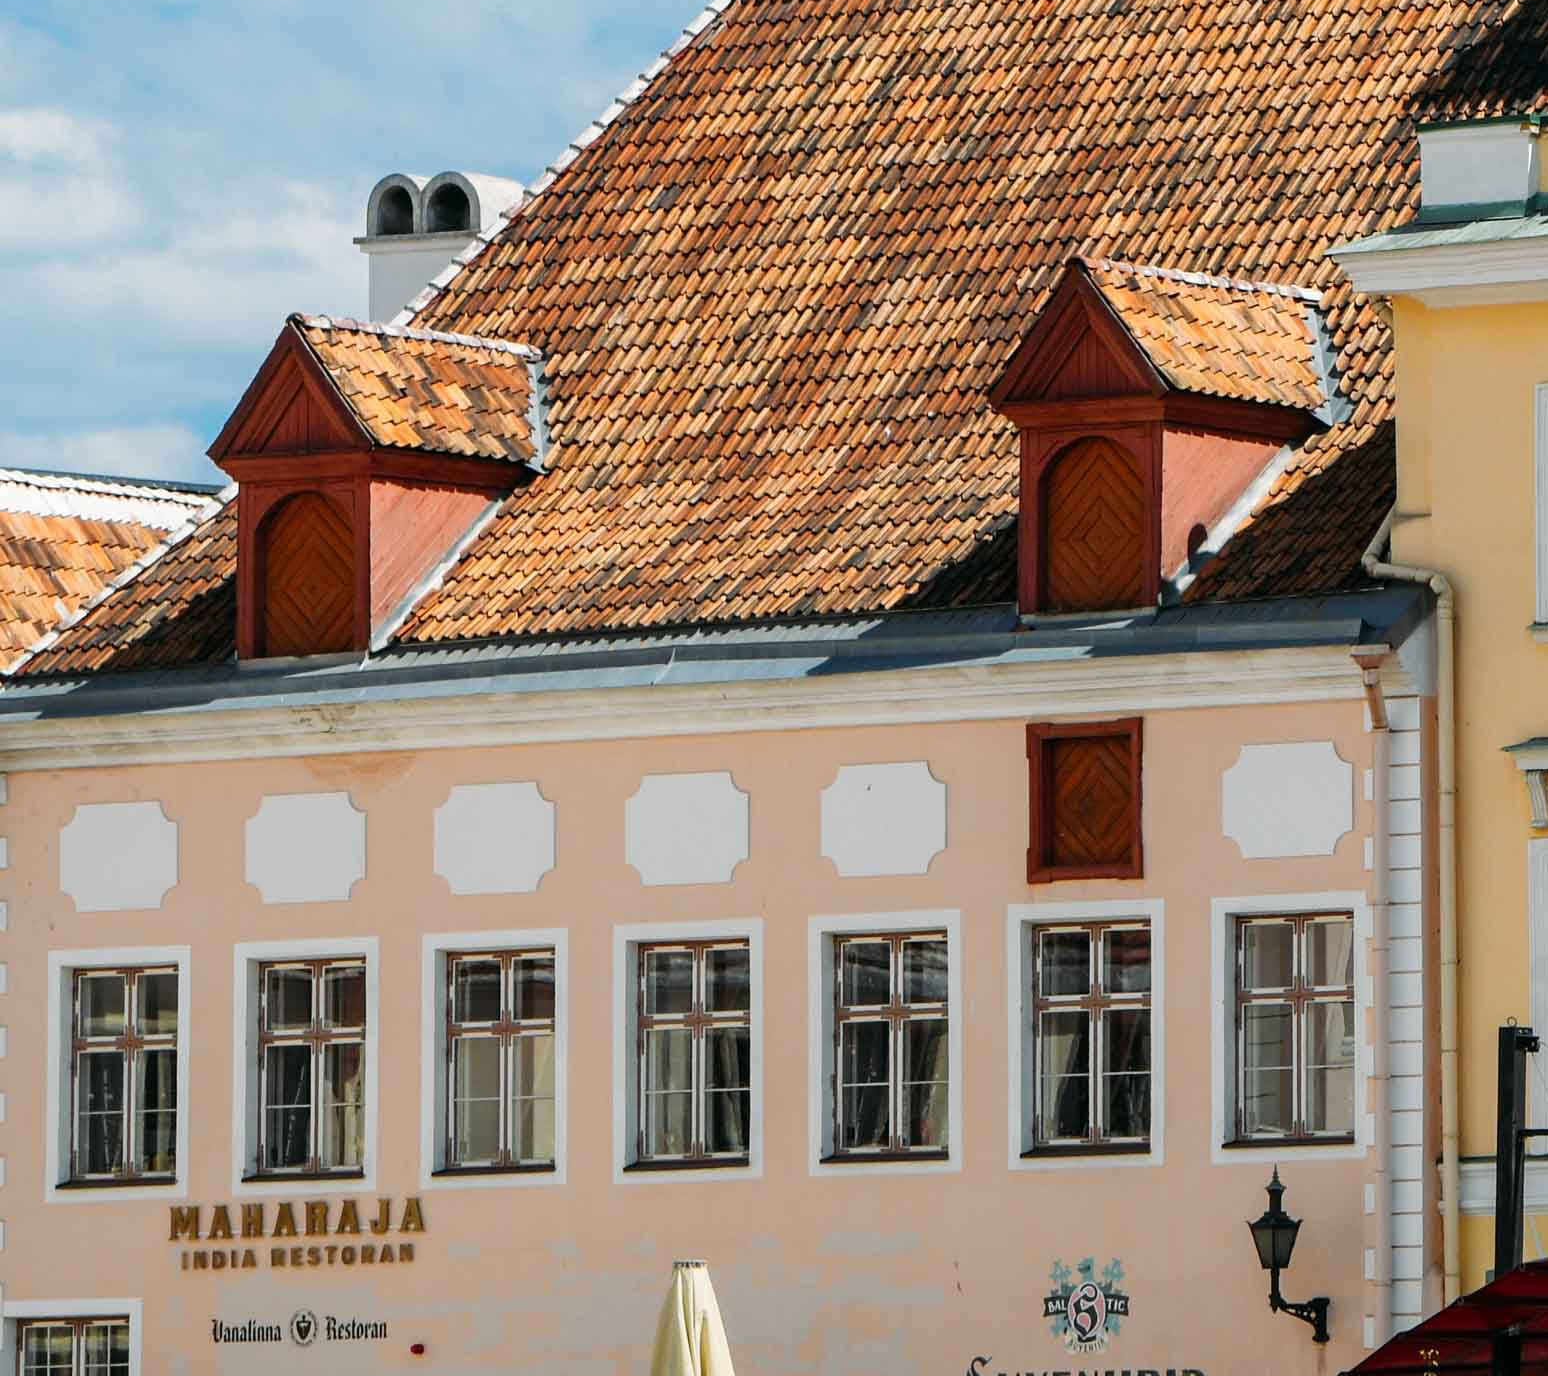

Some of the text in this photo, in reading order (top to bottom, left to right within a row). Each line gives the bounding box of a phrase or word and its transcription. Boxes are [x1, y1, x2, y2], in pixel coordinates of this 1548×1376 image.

[169, 1198, 425, 1241] MAHARAJA
[181, 1243, 415, 1271] INDIA RESTORAN
[212, 1316, 387, 1343] Vanalinna Restoran
